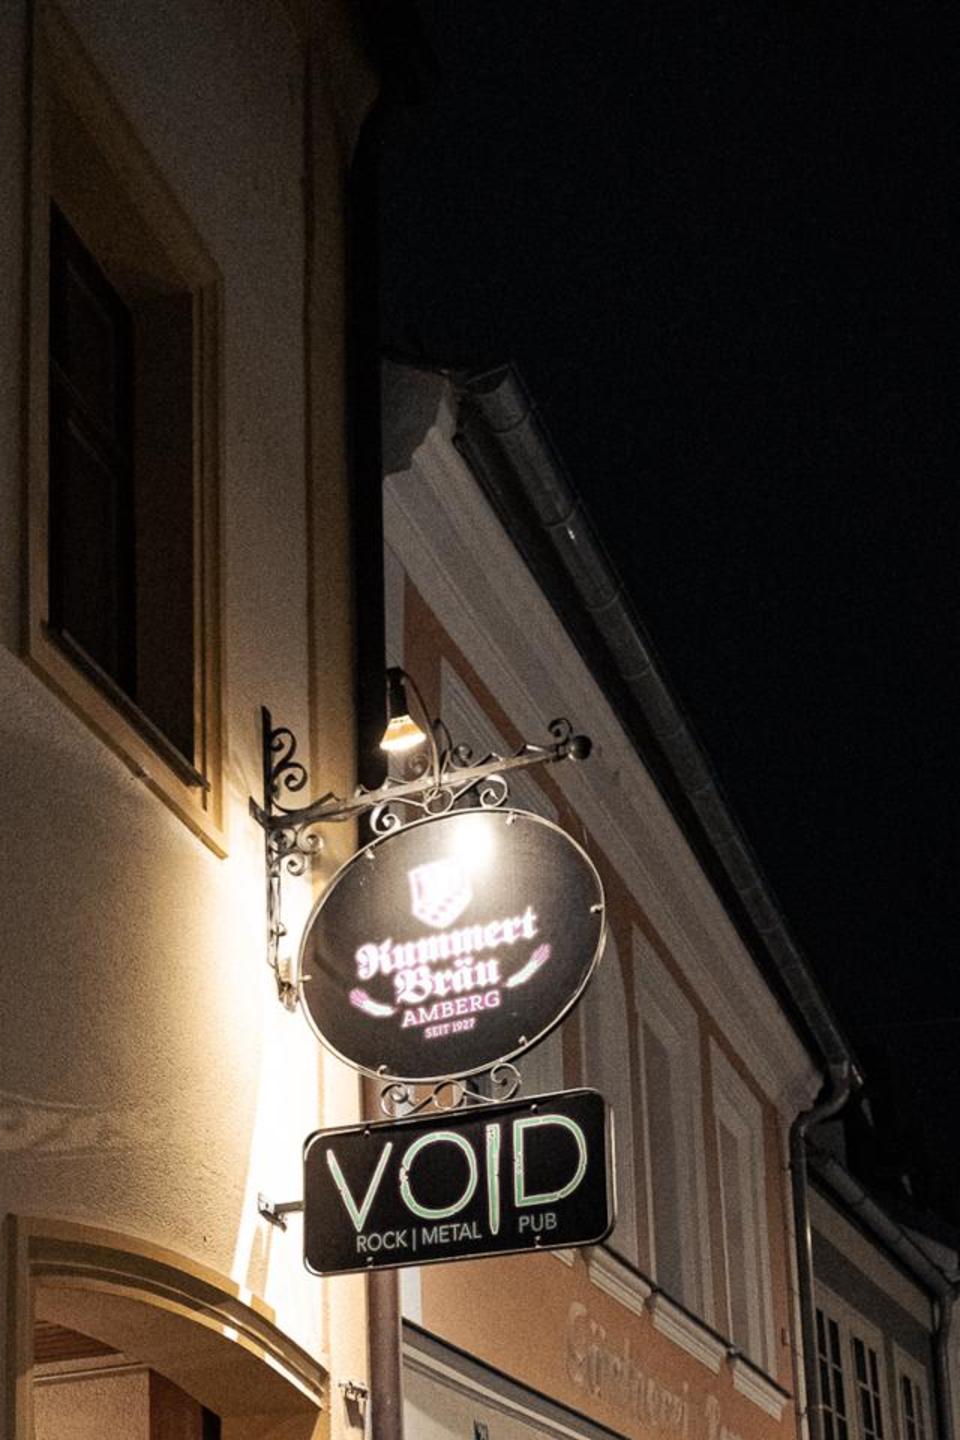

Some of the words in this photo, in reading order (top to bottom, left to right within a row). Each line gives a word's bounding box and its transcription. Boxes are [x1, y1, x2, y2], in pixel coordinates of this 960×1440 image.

[394, 956, 501, 1005] Bräu
[401, 990, 502, 1029] AMBERG
[424, 1022, 450, 1039] SEIT
[452, 1017, 477, 1034] 1927
[326, 1114, 587, 1236] VOID
[356, 1230, 407, 1254] ROCK
[421, 1221, 482, 1245] METAL
[518, 1212, 558, 1234] PUB
